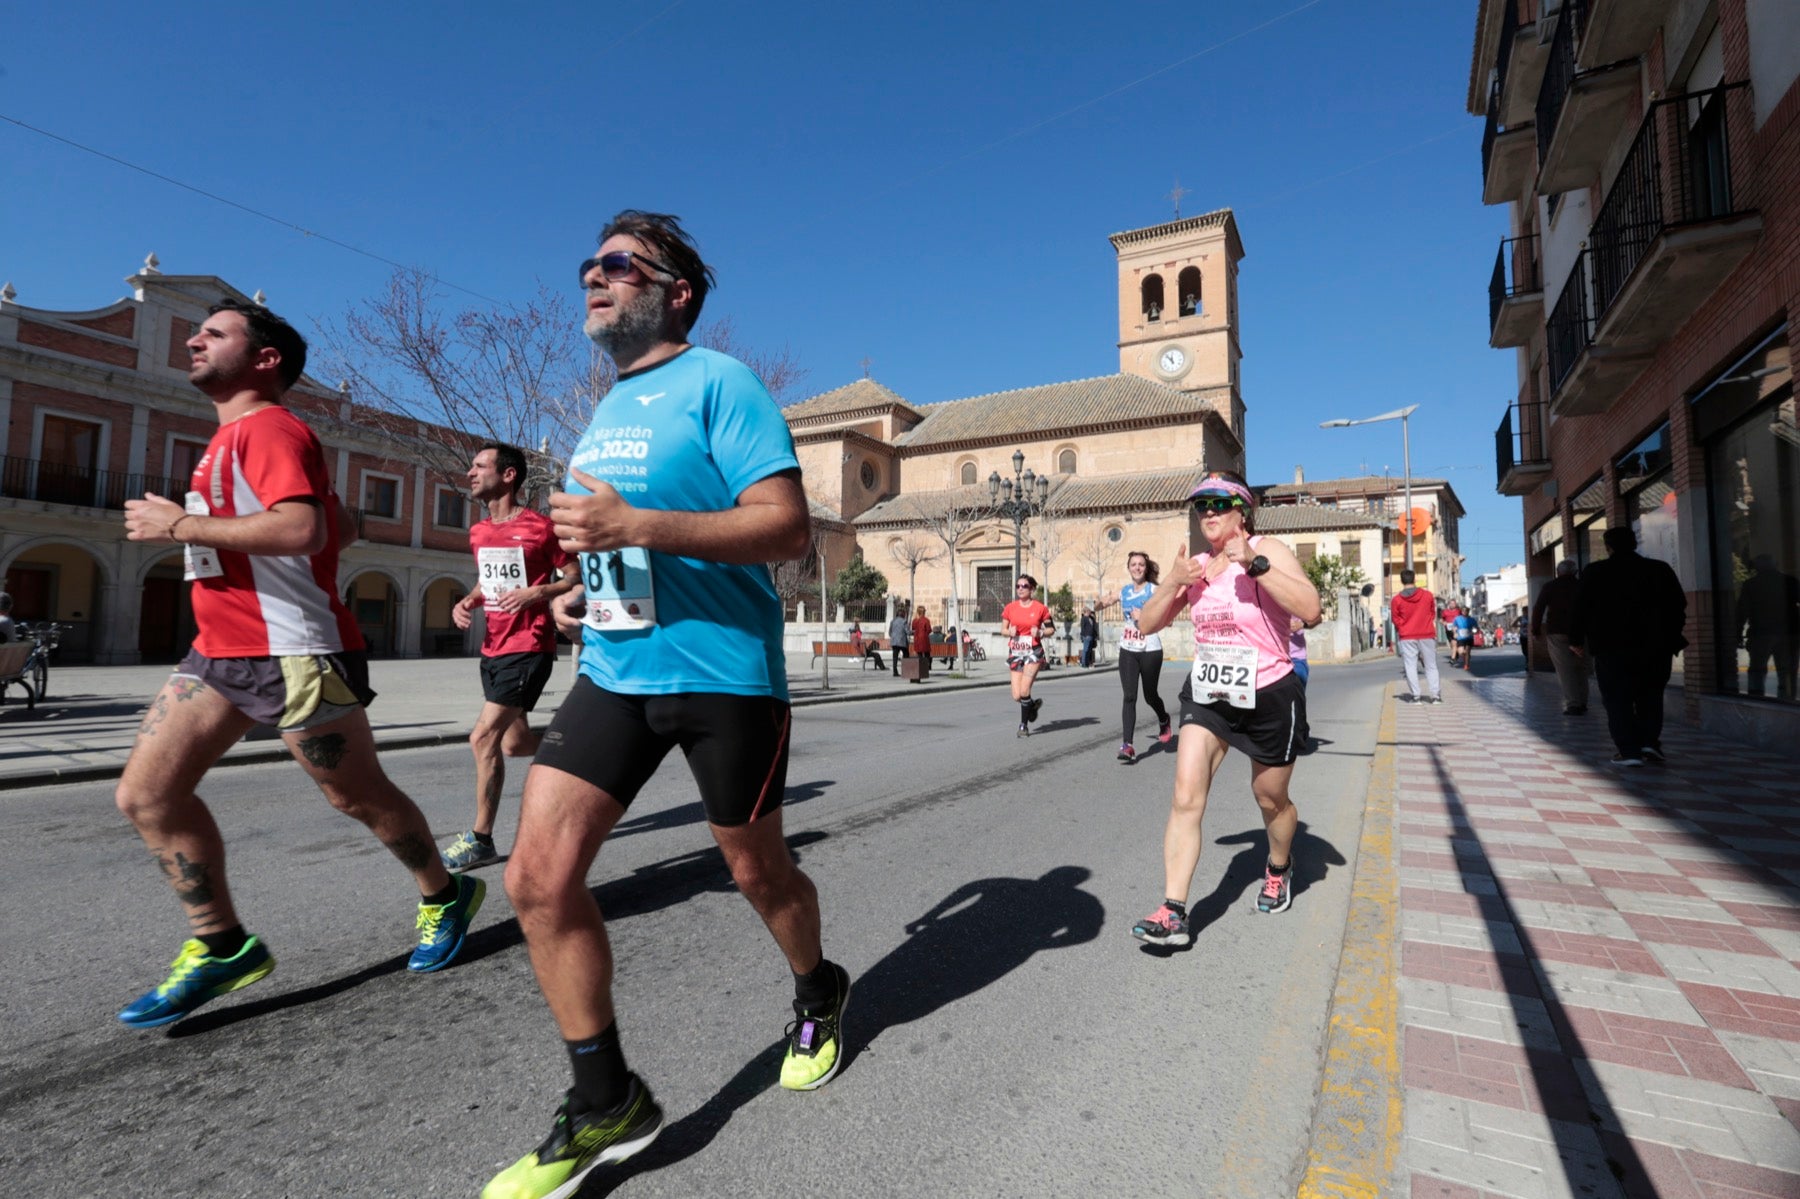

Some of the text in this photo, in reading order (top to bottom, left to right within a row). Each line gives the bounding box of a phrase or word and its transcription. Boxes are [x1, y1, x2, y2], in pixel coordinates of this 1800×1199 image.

[600, 440, 648, 460] 2020
[484, 563, 521, 579] 3146
[587, 550, 626, 592] 81
[1197, 663, 1250, 687] 3052
